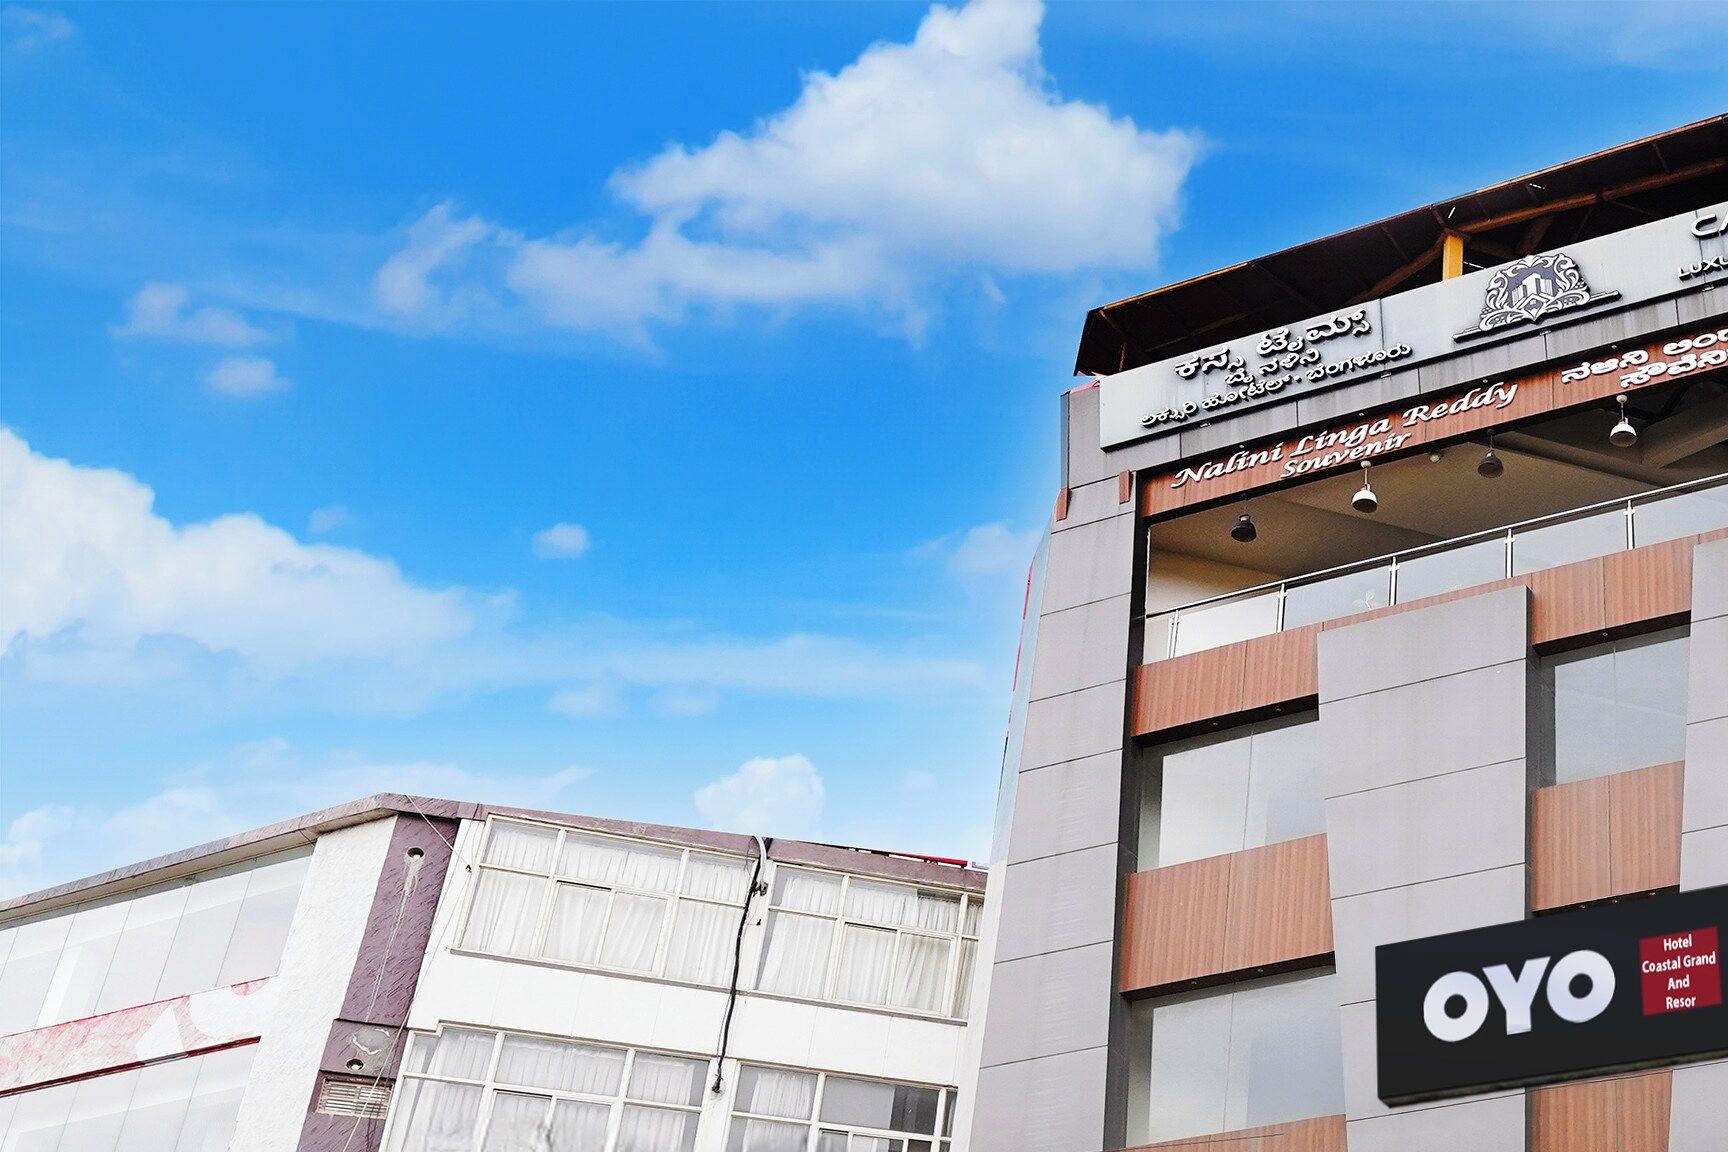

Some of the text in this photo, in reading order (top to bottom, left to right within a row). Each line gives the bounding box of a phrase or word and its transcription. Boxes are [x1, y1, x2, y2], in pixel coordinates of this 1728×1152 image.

[1170, 381, 1519, 489] Nalini Linga Reddy
[1280, 431, 1412, 479] Souvenir
[1663, 933, 1692, 951] Hotel
[1641, 950, 1716, 973] Coastal Grand
[1667, 974, 1690, 991] And
[1423, 949, 1616, 1042] OYO
[1666, 996, 1697, 1010] Resor
